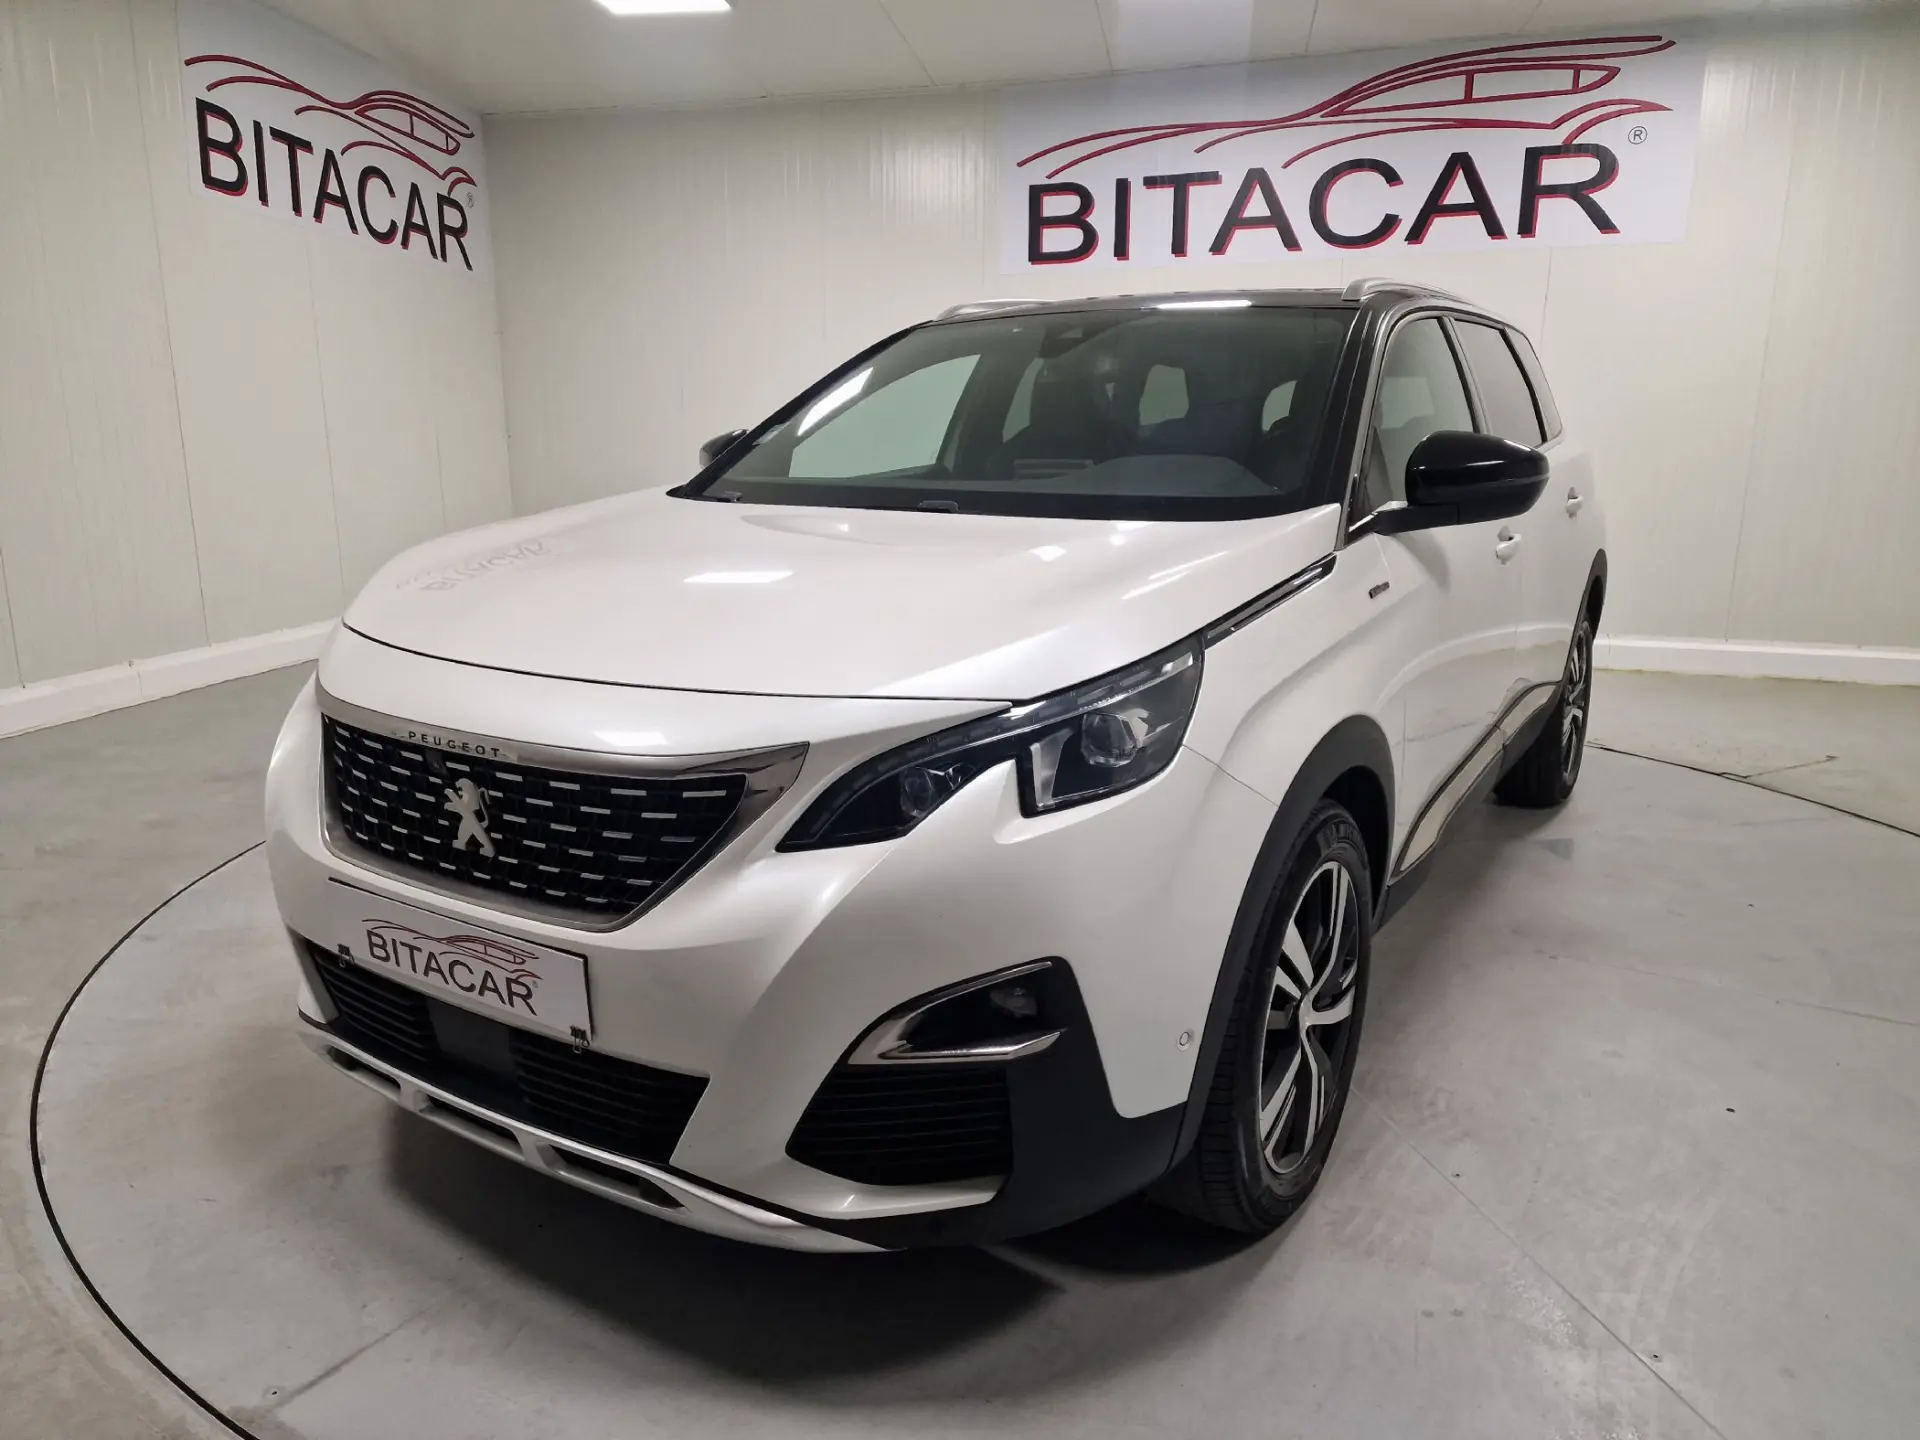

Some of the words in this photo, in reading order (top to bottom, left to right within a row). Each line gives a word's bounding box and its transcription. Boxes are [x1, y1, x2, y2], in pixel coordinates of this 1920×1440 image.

[196, 97, 473, 271] BITACAR
[1028, 143, 1620, 265] BITACAR
[408, 730, 500, 757] PEUGEOT
[366, 929, 538, 1016] BITACAR
